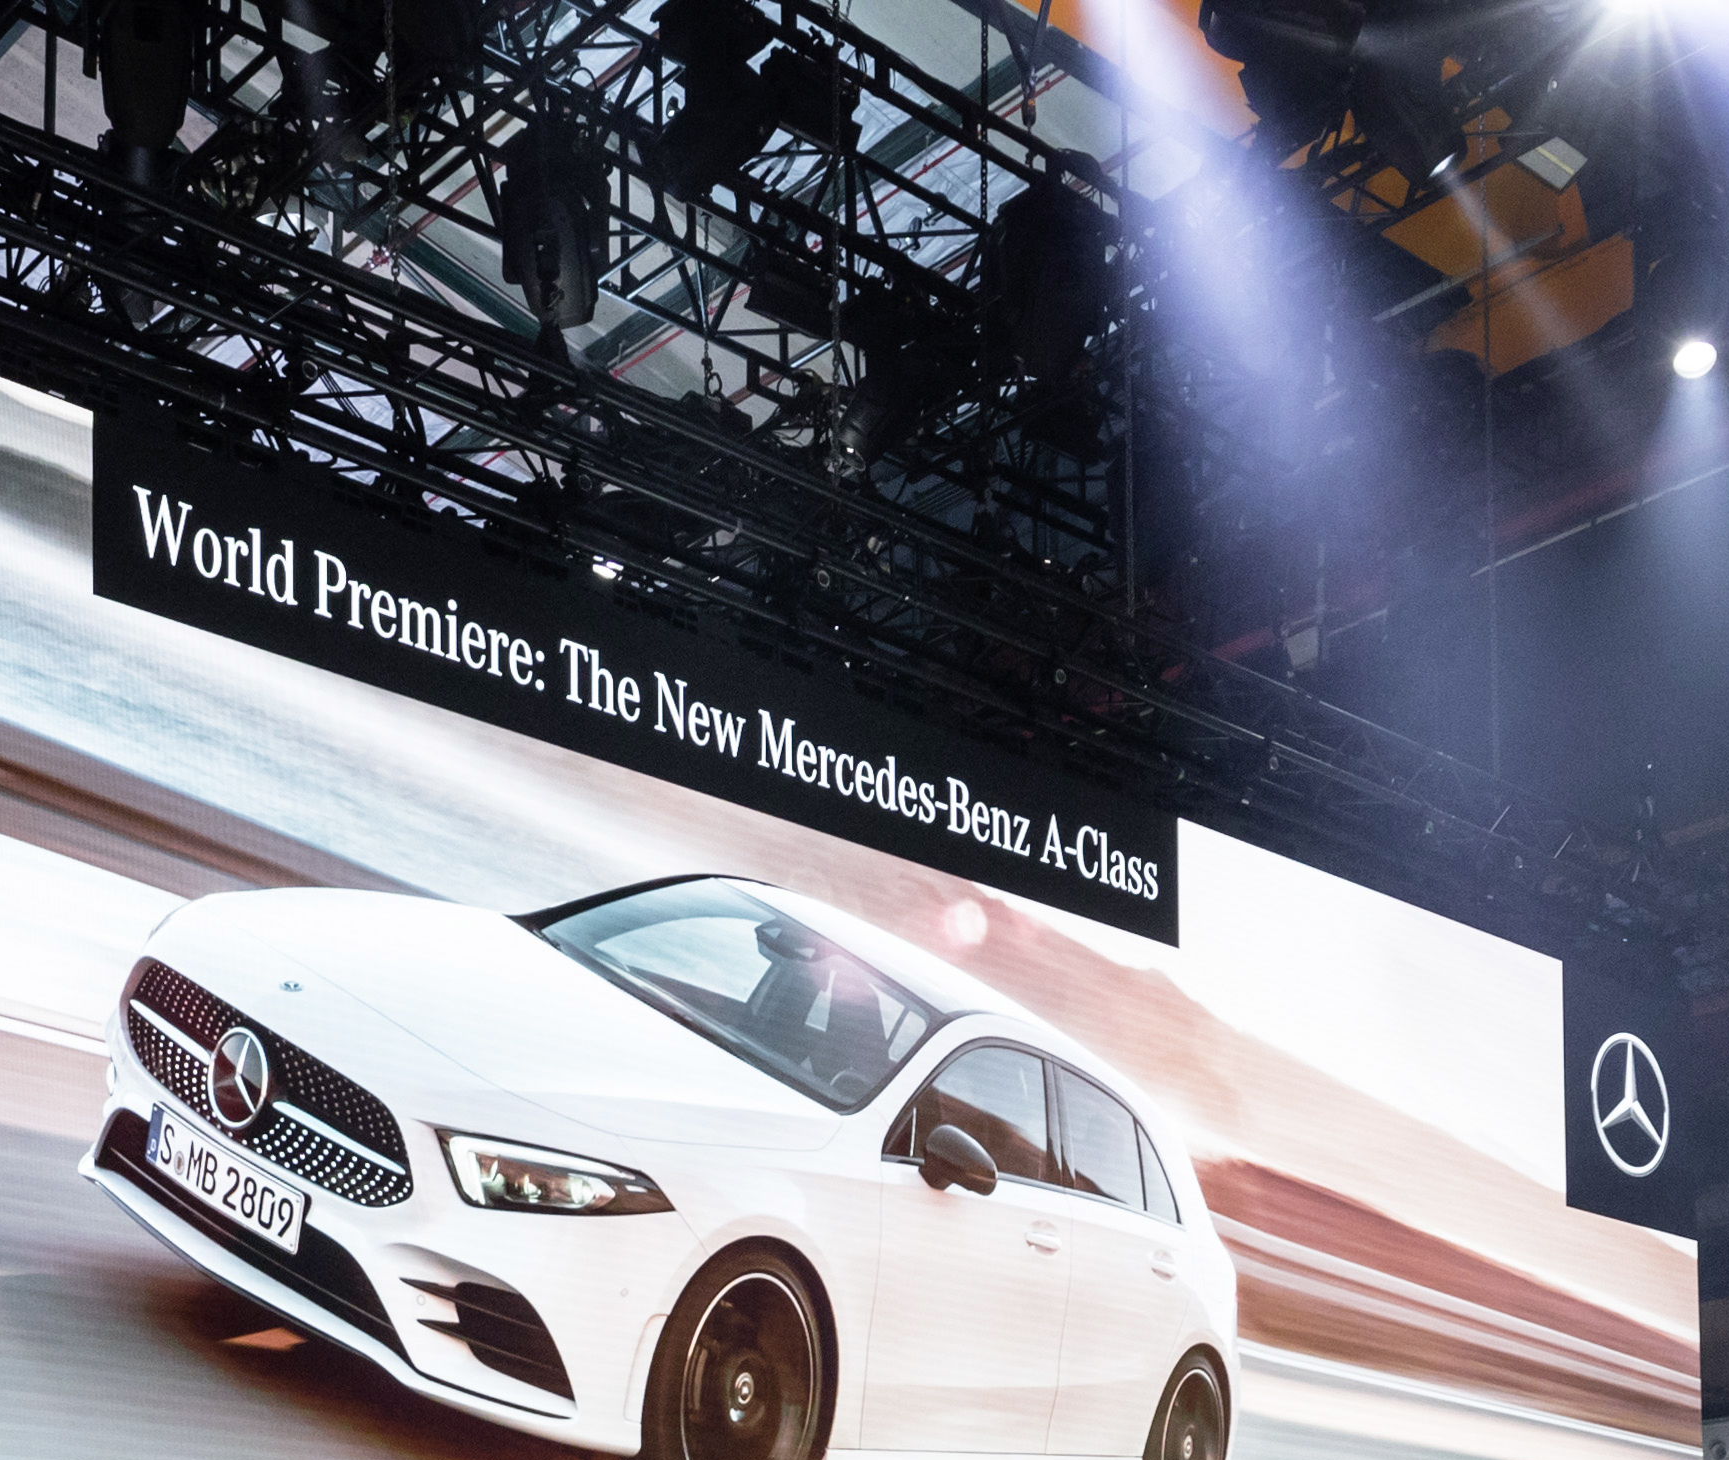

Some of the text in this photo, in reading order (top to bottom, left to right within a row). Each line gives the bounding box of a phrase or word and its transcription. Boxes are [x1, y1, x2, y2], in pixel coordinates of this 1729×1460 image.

[131, 484, 1160, 902] World Premiere: The New Mercedes-Benz A-Class
[160, 1124, 295, 1238] S MB 2809
